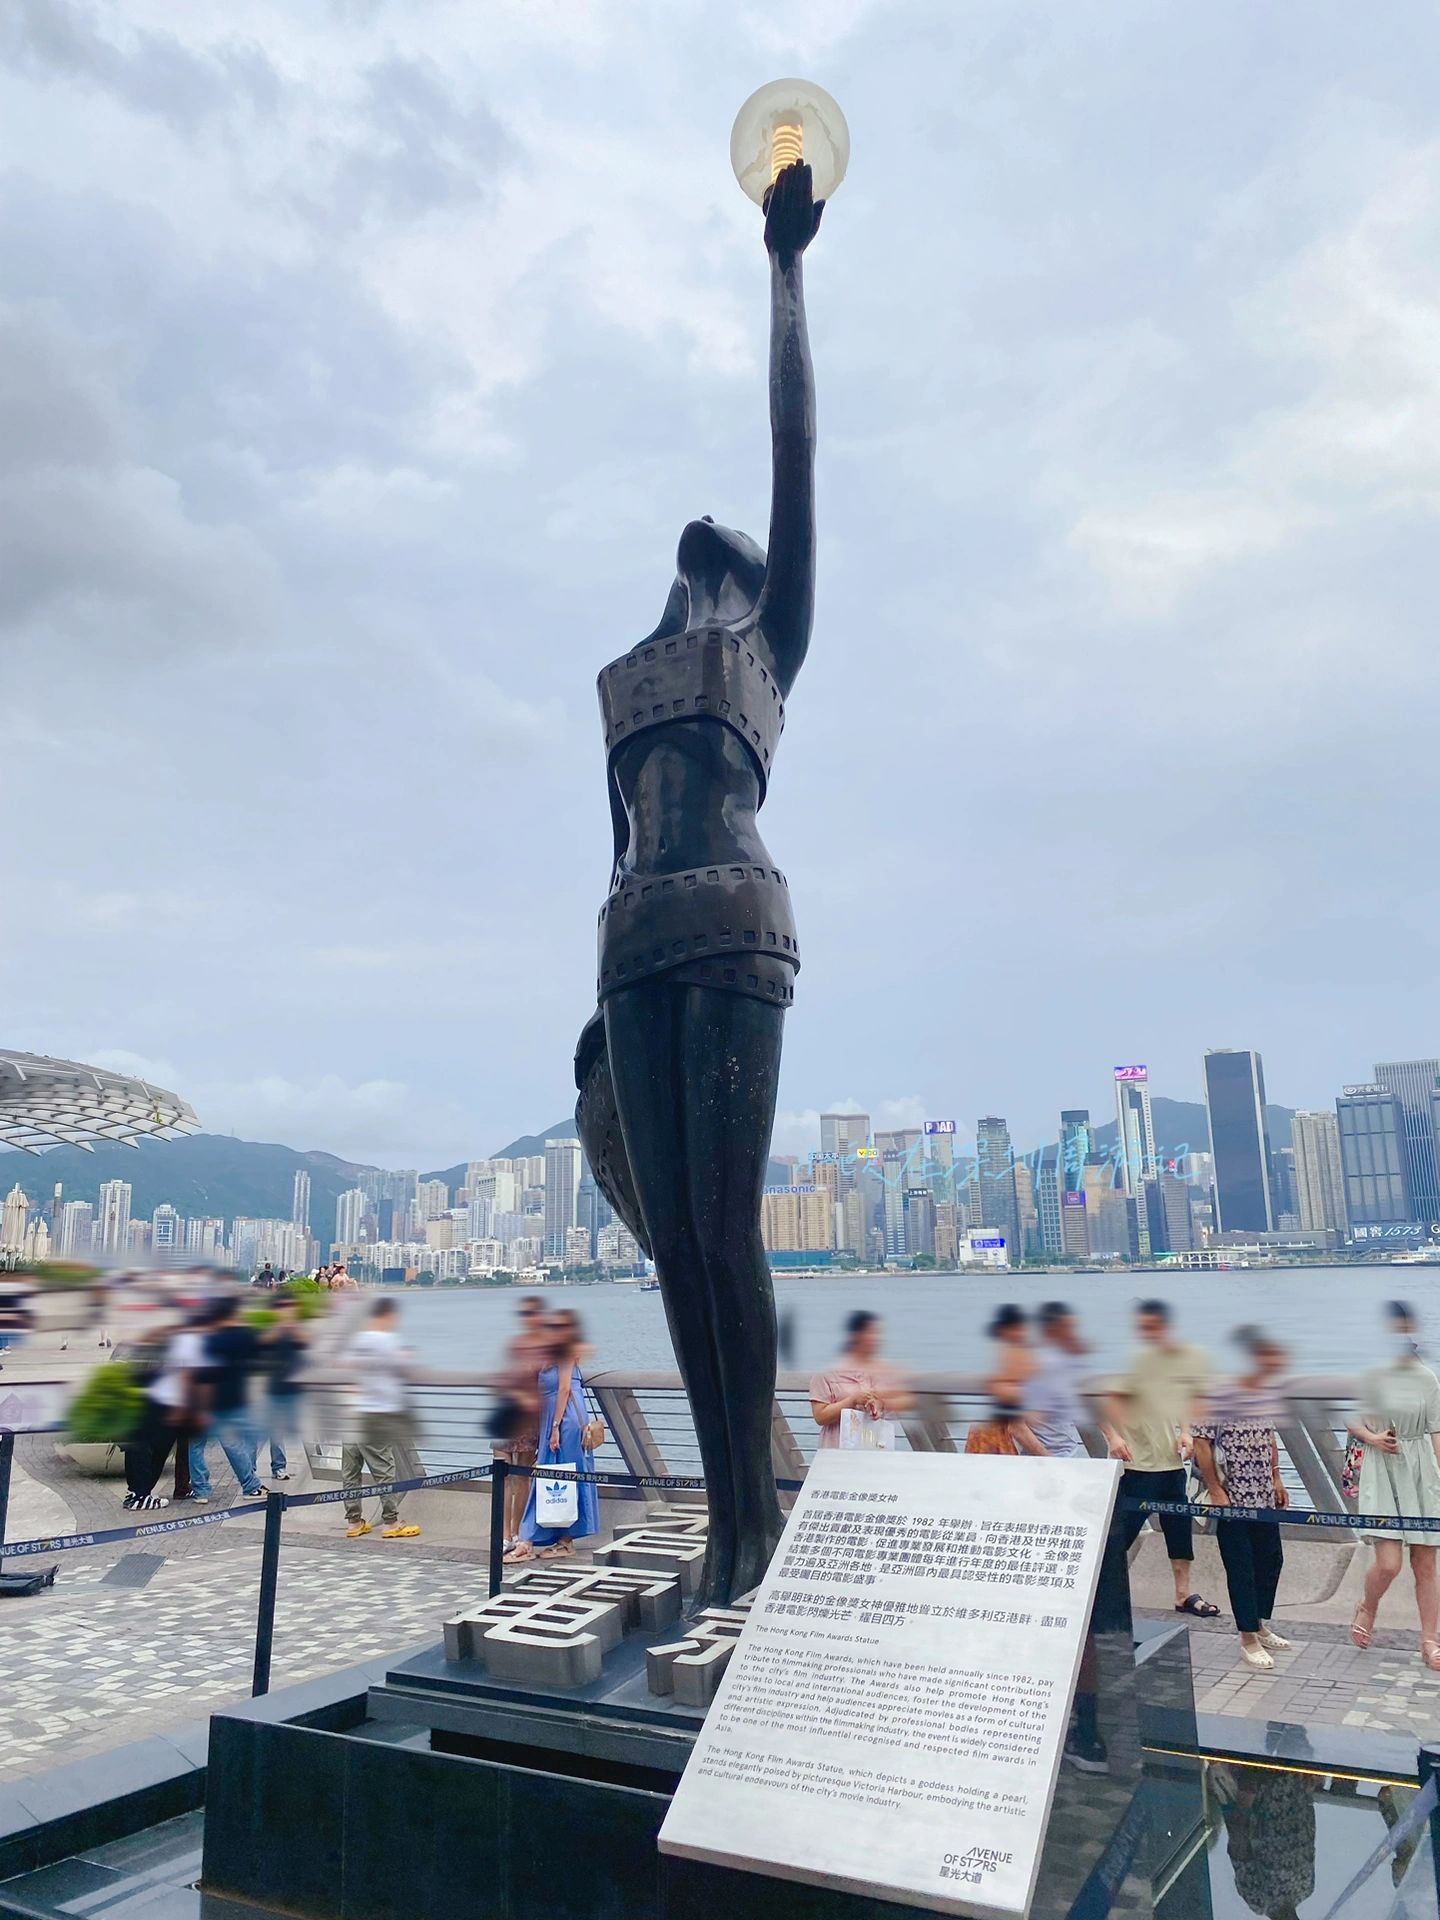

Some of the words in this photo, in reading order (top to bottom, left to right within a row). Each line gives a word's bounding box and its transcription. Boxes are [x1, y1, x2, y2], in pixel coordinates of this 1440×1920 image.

[762, 1184, 816, 1195] anasonic
[810, 1490, 899, 1504] 香港電影金像獎女神
[1139, 1501, 1175, 1512] AVENUE
[1176, 1504, 1188, 1513] OF
[136, 1525, 166, 1536] AVENUE
[166, 1522, 177, 1530] OF
[912, 1517, 935, 1526] 1982
[1306, 1514, 1348, 1526] AVENUE
[1349, 1516, 1361, 1526] OF
[17, 1543, 30, 1554] OF
[756, 1624, 769, 1633] The
[769, 1626, 789, 1636] Hong
[789, 1628, 809, 1638] Kong
[809, 1630, 825, 1639] Film
[825, 1632, 853, 1642] Awards
[854, 1635, 880, 1645] Statue
[743, 1653, 770, 1663] tribute
[823, 1664, 877, 1677] professionals
[879, 1670, 897, 1679] who
[897, 1672, 917, 1681] have
[918, 1676, 943, 1684] made
[944, 1678, 989, 1690] significant
[990, 1684, 1051, 1698] contributions
[747, 1644, 762, 1652] The
[763, 1645, 784, 1656] Hong
[784, 1648, 804, 1658] Kong
[805, 1650, 822, 1659] Film
[857, 1657, 881, 1666] which
[882, 1660, 902, 1669] have
[904, 1662, 926, 1671] been
[927, 1664, 947, 1674] held
[948, 1668, 985, 1680] annually
[986, 1672, 1009, 1681] since
[1037, 1679, 1055, 1688] pay
[735, 1674, 762, 1683] movies
[774, 1677, 794, 1687] local
[812, 1682, 865, 1696] international
[912, 1695, 939, 1706] foster
[958, 1701, 1017, 1717] development
[850, 1676, 866, 1686] The
[869, 1679, 899, 1690] Awards
[903, 1684, 921, 1692] also
[925, 1686, 945, 1697] help
[948, 1690, 987, 1701] promote
[991, 1694, 1015, 1706] Hong
[744, 1696, 774, 1706] artistic
[824, 1706, 876, 1720] Adjudicated
[891, 1716, 946, 1729] professional
[948, 1722, 979, 1734] bodies
[982, 1729, 1042, 1745] representing
[767, 1687, 800, 1700] industry
[816, 1693, 834, 1704] help
[835, 1697, 876, 1709] audiences
[877, 1703, 923, 1715] appreciate
[924, 1709, 954, 1719] movies
[974, 1714, 996, 1725] form
[1008, 1721, 1045, 1731] cultural
[723, 1703, 756, 1714] different
[755, 1707, 794, 1721] disciplines
[795, 1713, 818, 1723] within
[927, 1733, 951, 1742] event
[960, 1737, 988, 1749] widely
[988, 1741, 1040, 1755] considered
[786, 1724, 807, 1733] most
[809, 1726, 852, 1739] influential
[853, 1734, 902, 1747] recognised
[922, 1744, 970, 1757] respected
[991, 1754, 1025, 1765] awards
[707, 1745, 721, 1754] The
[723, 1748, 743, 1759] Hong
[745, 1751, 765, 1763] Kong
[767, 1754, 784, 1764] Film
[785, 1757, 815, 1769] Awards
[849, 1768, 873, 1779] which
[875, 1772, 907, 1785] depicts
[917, 1780, 954, 1792] goddess
[957, 1785, 990, 1800] holding
[702, 1757, 727, 1767] stands
[728, 1761, 764, 1774] elegantly
[762, 1767, 792, 1778] poised
[802, 1772, 852, 1788] picturesque
[853, 1780, 886, 1793] Victoria
[926, 1794, 975, 1810] embodying
[993, 1805, 1026, 1817] artistic
[713, 1770, 744, 1781] cultural
[744, 1776, 789, 1789] endeavours
[839, 1792, 864, 1802] movie
[943, 1853, 959, 1865] OF
[966, 1847, 1013, 1864] AVENUE
[939, 1866, 983, 1884] 星光大道
